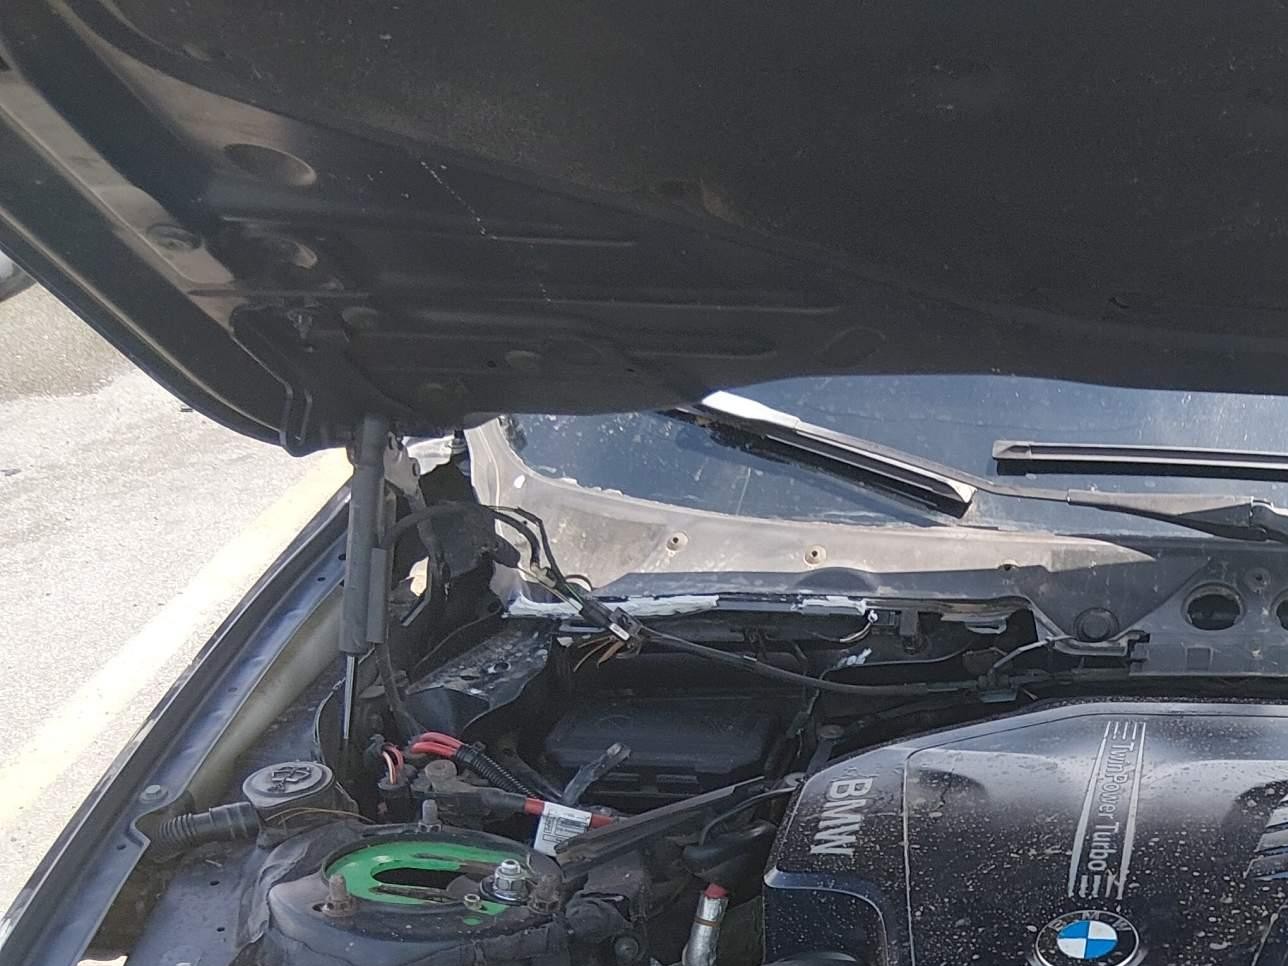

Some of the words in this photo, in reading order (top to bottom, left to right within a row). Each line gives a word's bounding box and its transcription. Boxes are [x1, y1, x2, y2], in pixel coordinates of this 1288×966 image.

[1097, 741, 1135, 820] TwinPower
[810, 777, 873, 855] BMW
[1087, 821, 1120, 872] Turbo
[1047, 910, 1133, 932] BMW
